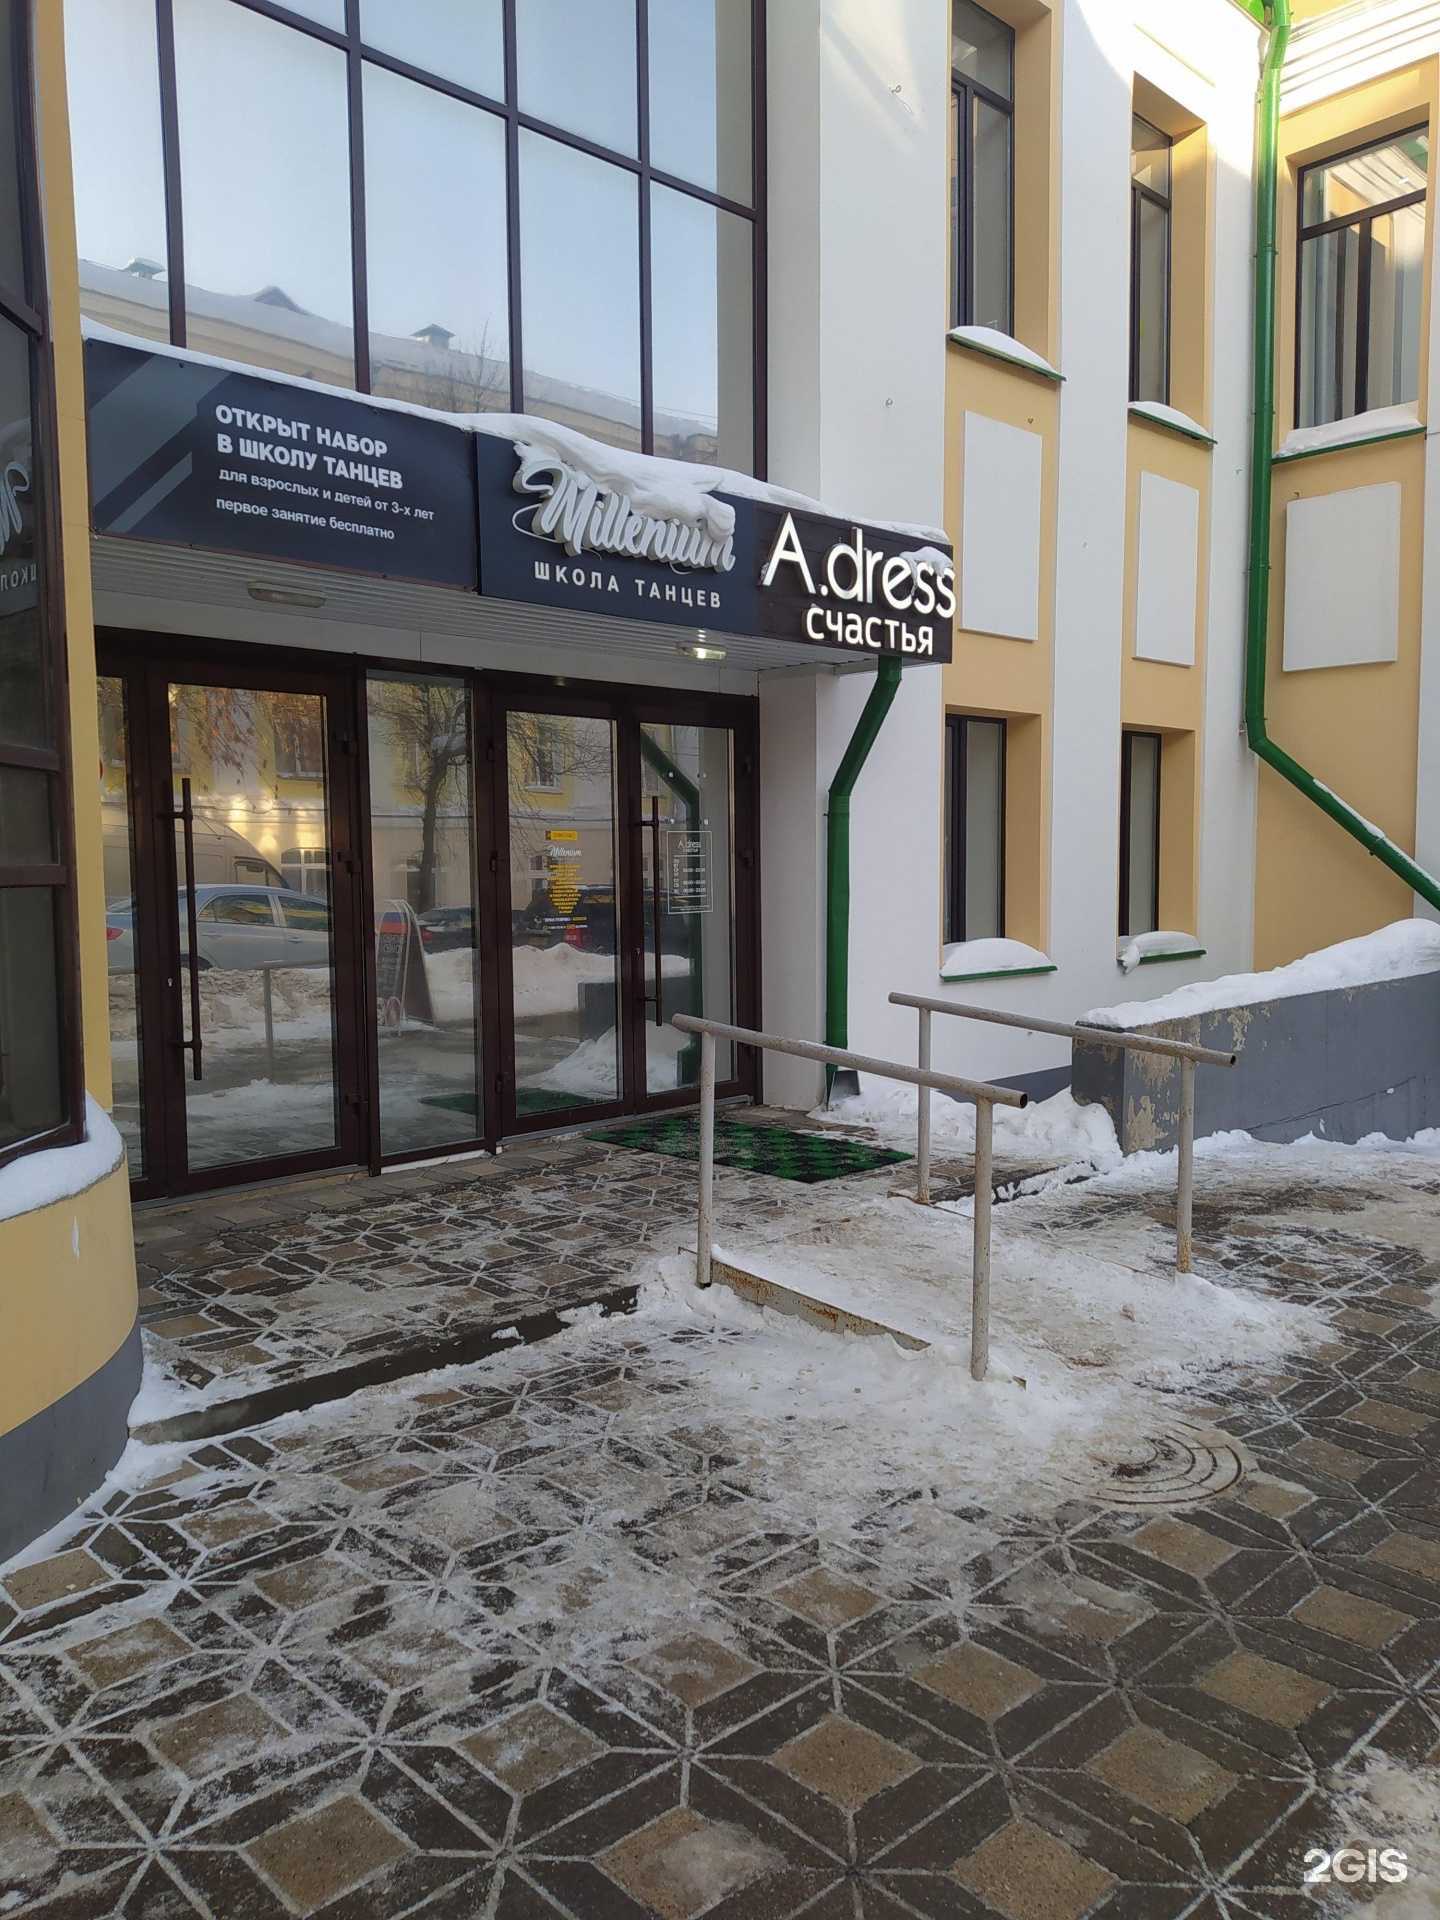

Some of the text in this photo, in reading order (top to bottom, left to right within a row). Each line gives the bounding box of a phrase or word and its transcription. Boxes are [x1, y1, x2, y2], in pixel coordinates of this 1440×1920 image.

[215, 404, 388, 458] ОТКРЫТ НАБОР
[217, 433, 403, 489] В ШКОЛУ ТАНЦЕВ
[216, 498, 395, 540] первое занятие бесплатно
[219, 469, 436, 520] для взрослых и детей от 3-х лет
[512, 462, 736, 575] Millenium
[534, 560, 721, 608] ШКОЛА ТАНЦЕВ
[761, 511, 957, 619] A.dress
[805, 606, 933, 656] счастья
